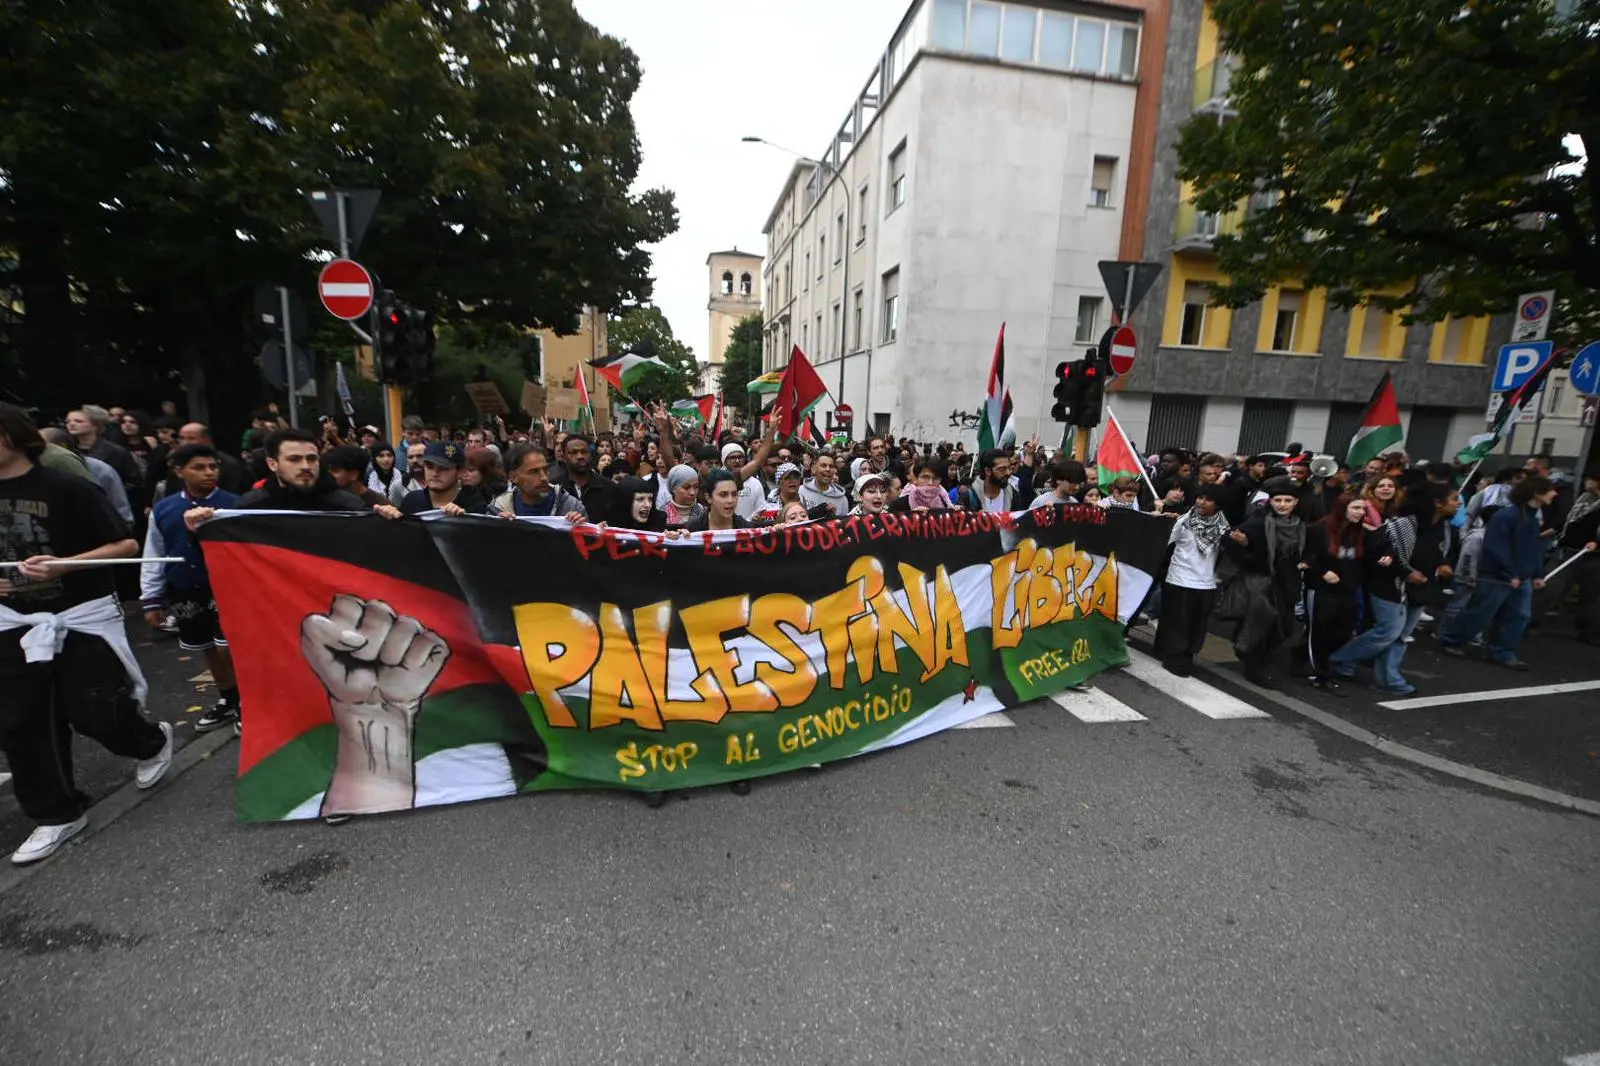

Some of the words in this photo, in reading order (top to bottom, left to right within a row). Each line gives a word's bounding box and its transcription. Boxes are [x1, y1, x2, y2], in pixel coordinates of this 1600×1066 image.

[1502, 348, 1540, 387] P
[572, 526, 669, 560] PER
[1018, 649, 1070, 687] FREE
[615, 740, 698, 781] STOP
[725, 732, 761, 765] AL
